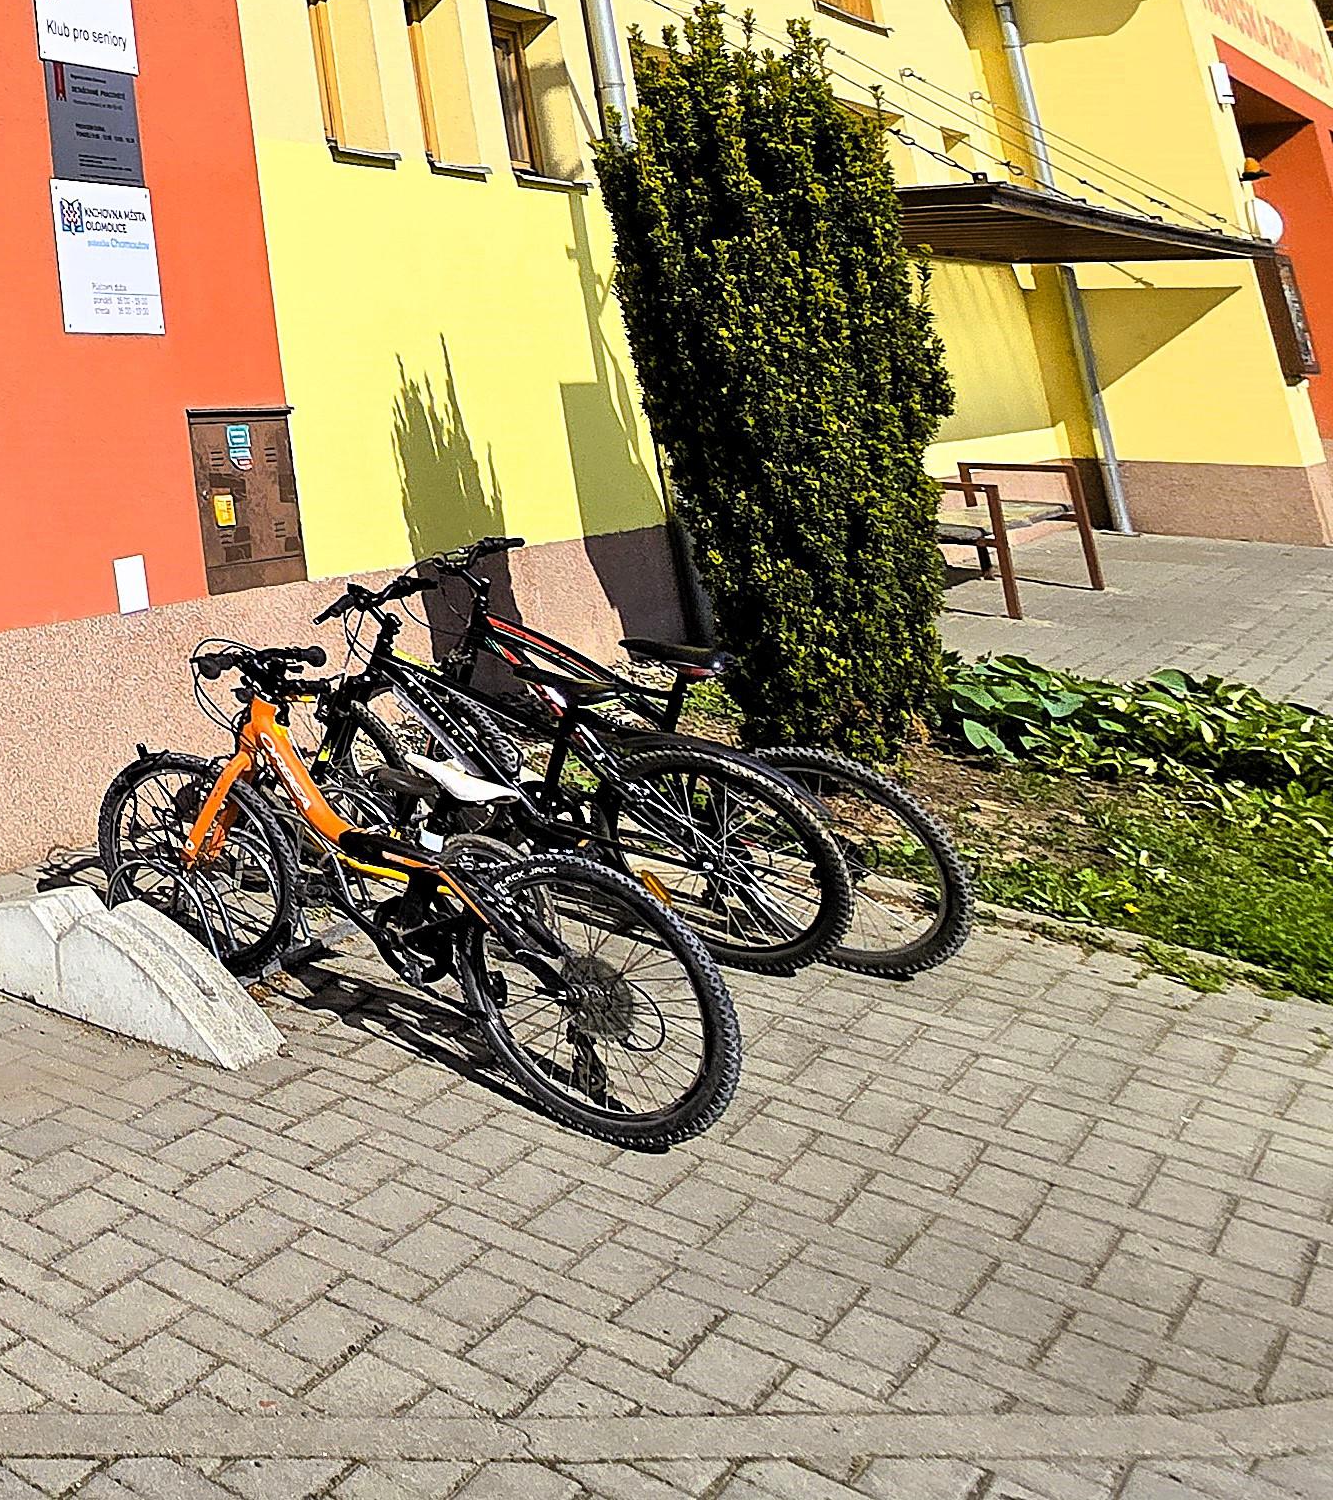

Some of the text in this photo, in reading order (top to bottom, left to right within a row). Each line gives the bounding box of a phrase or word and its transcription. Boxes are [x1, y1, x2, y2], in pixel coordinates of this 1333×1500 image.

[46, 18, 127, 52] Klub pro seniory
[84, 207, 147, 221] KNIHOVNA MĚSTA
[85, 220, 128, 234] OLOMOUCE
[260, 732, 312, 811] ORBEA
[493, 866, 557, 896] BLACK JACK
